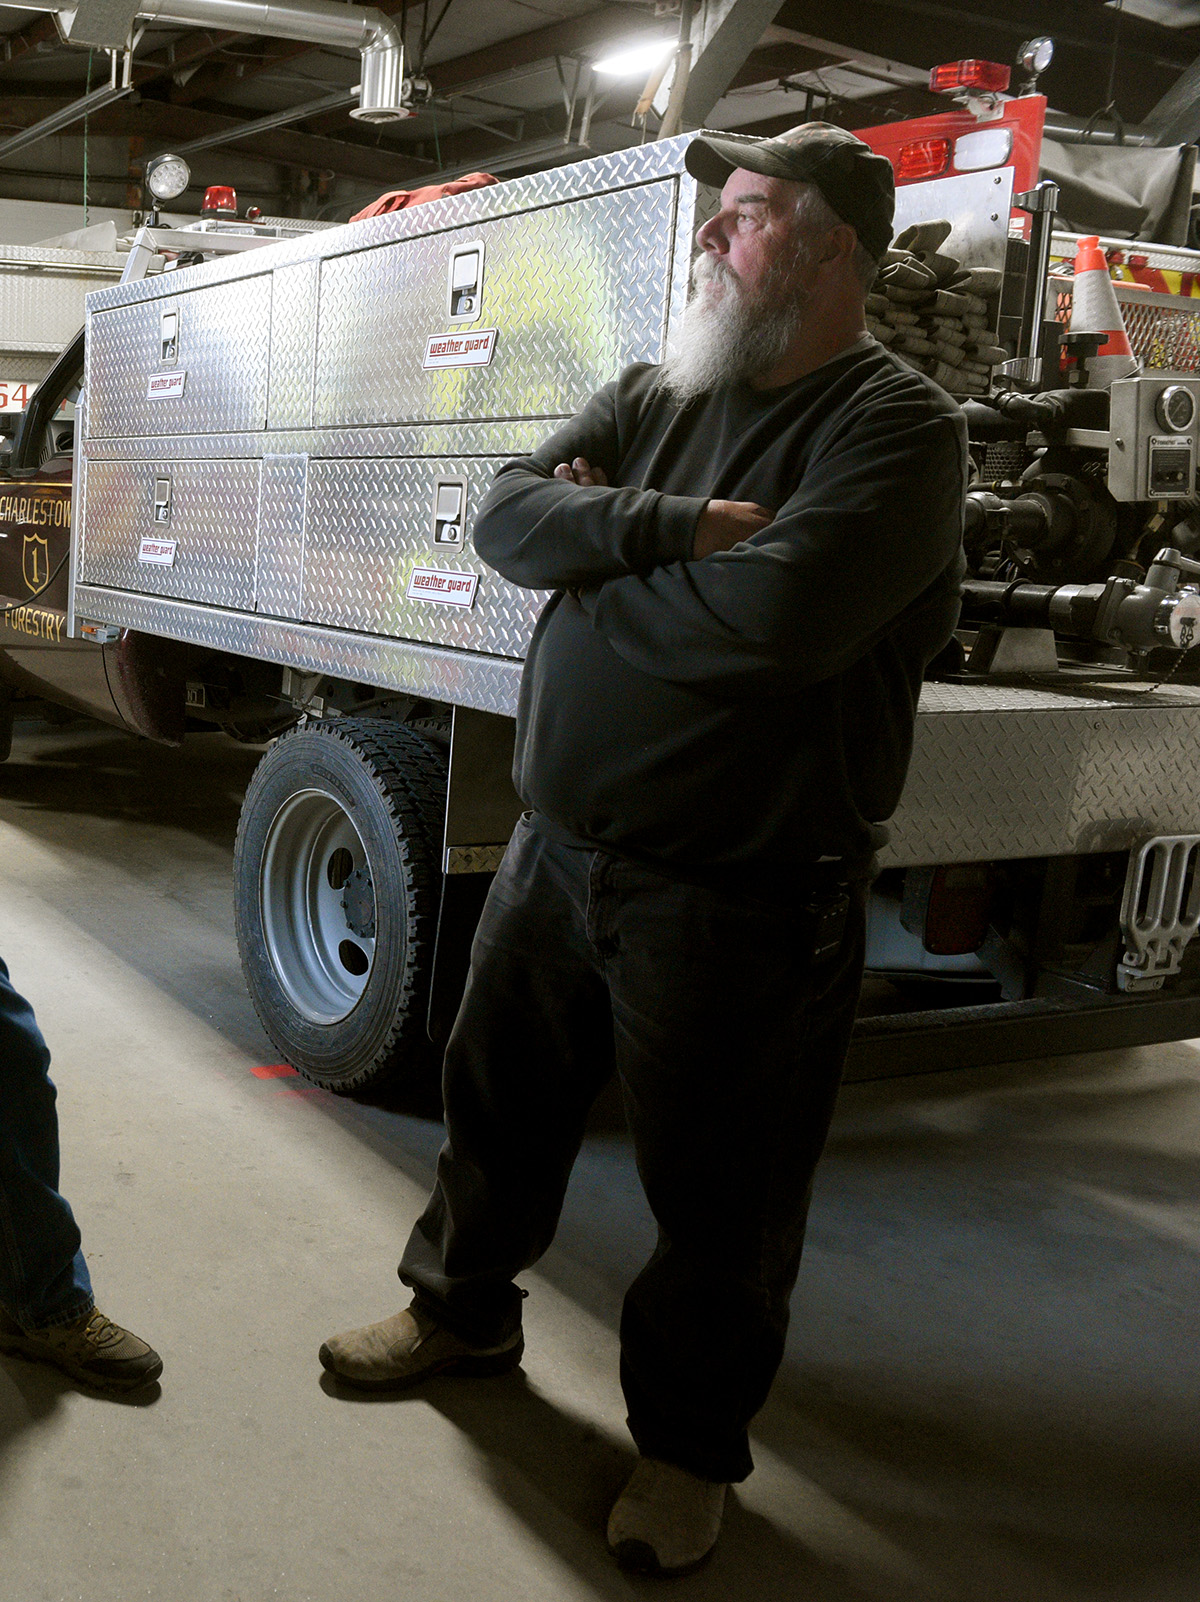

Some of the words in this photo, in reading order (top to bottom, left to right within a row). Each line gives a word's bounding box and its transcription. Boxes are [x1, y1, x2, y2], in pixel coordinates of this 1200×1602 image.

[429, 338, 463, 355] weather
[464, 335, 490, 354] guard
[31, 547, 40, 583] 1
[413, 574, 447, 589] weather
[447, 579, 472, 593] guard
[4, 602, 66, 643] FORESTRY
